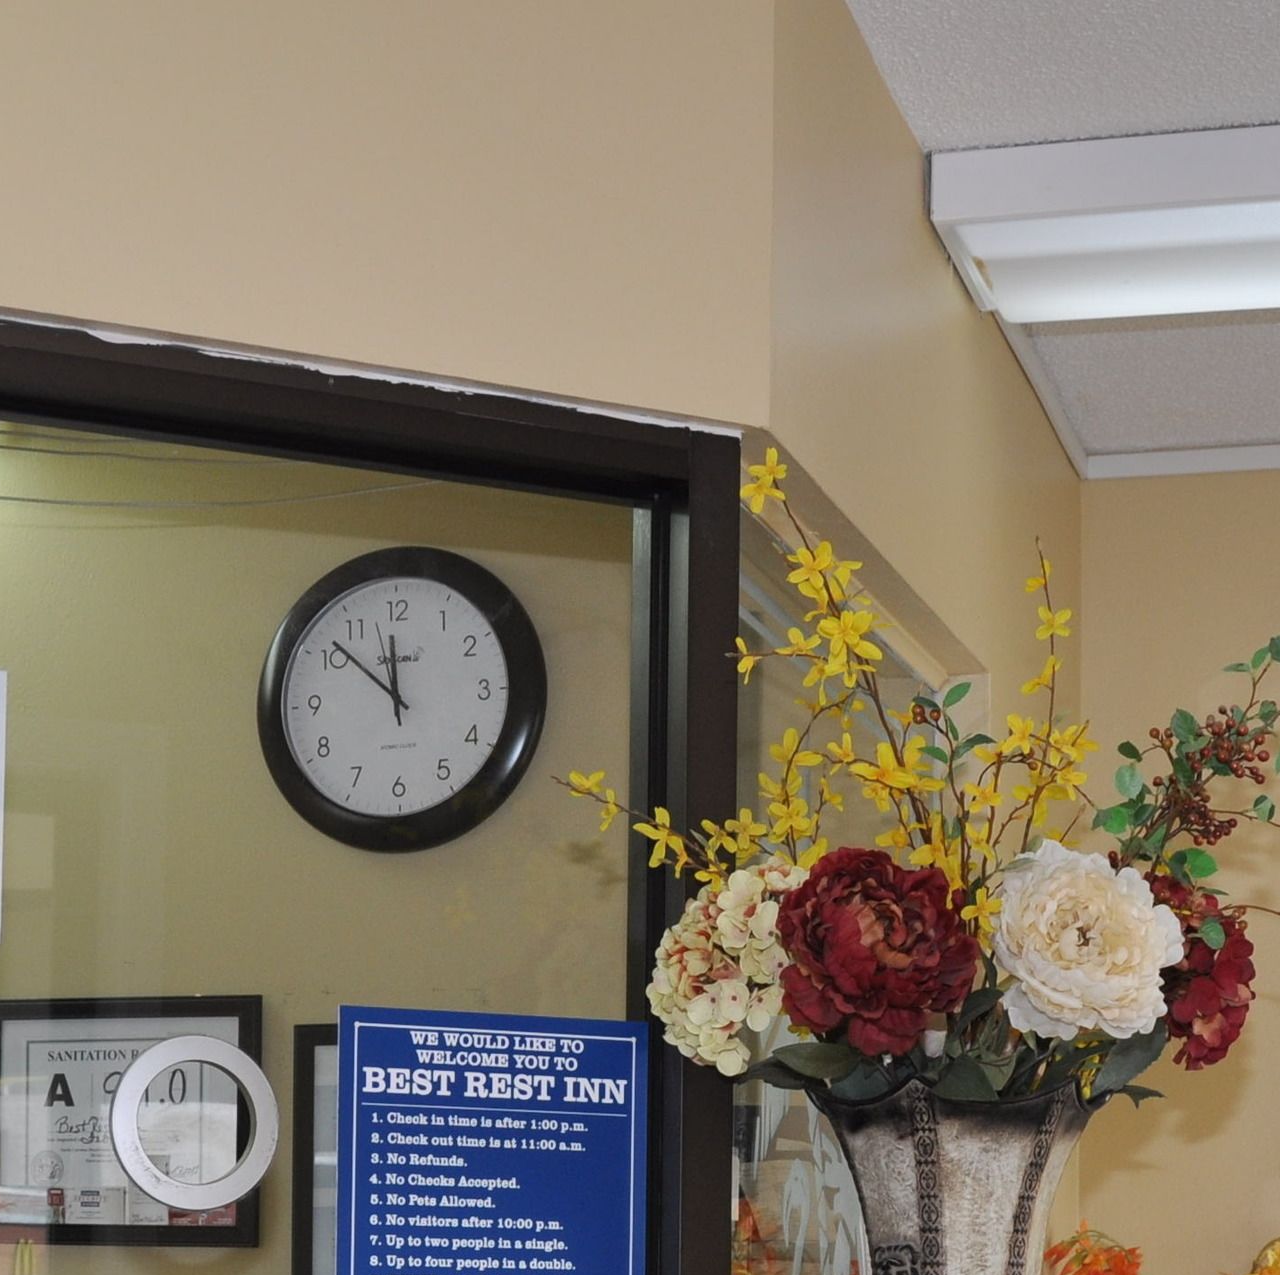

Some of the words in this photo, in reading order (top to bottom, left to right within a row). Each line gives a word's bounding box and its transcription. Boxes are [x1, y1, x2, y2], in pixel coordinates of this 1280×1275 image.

[386, 600, 408, 622] 12
[439, 610, 445, 631] 1
[346, 619, 364, 640] 11
[463, 635, 477, 657] 2
[321, 648, 350, 671] 10
[477, 680, 491, 700] 3
[308, 695, 321, 716] 9
[464, 724, 478, 745] 4
[317, 736, 330, 757] 8
[351, 766, 362, 787] 7
[437, 759, 450, 780] 5
[392, 776, 406, 797] 6
[410, 1031, 438, 1046] WE
[444, 1033, 509, 1049] WOULD
[514, 1038, 556, 1052] LIKE
[560, 1039, 584, 1053] TO
[47, 1050, 127, 1061] SANITATION
[417, 1050, 508, 1067] WELCOME
[513, 1055, 550, 1070] YOU
[554, 1057, 578, 1071] TO
[44, 1073, 75, 1107] A
[362, 1067, 455, 1095] BEST
[464, 1072, 555, 1101] REST
[564, 1077, 627, 1104] INN
[372, 1112, 383, 1123] 1.
[387, 1112, 427, 1125] Check
[431, 1114, 445, 1125] in
[448, 1115, 477, 1127] time
[481, 1117, 492, 1127] is
[496, 1117, 526, 1129] after
[531, 1119, 557, 1131] 1:00
[561, 1122, 588, 1133] p.m.
[372, 1133, 383, 1143] 2.
[387, 1133, 428, 1146] Check
[432, 1136, 453, 1147] out
[457, 1136, 485, 1148] time
[489, 1137, 500, 1148] is
[504, 1138, 517, 1149] at
[521, 1139, 556, 1150] 11:00
[559, 1142, 585, 1151] a.m.
[371, 1154, 383, 1164] 3.
[387, 1154, 406, 1165] No
[409, 1155, 467, 1167] Refunds.
[369, 1174, 381, 1185] 4.
[385, 1174, 405, 1185] No
[408, 1175, 455, 1187] Checks
[458, 1177, 520, 1190] Accepted.
[370, 1195, 382, 1205] 5.
[386, 1194, 405, 1206] No
[409, 1195, 436, 1207] Pets
[440, 1196, 495, 1208] Allowed.
[370, 1215, 381, 1225] 6.
[386, 1215, 405, 1226] No
[408, 1216, 458, 1227] visitors
[462, 1217, 493, 1229] after
[498, 1218, 532, 1229] 10:00
[536, 1221, 563, 1231] p.m.
[370, 1235, 381, 1246] 7.
[386, 1235, 405, 1249] Up
[408, 1237, 421, 1247] to
[425, 1237, 449, 1248] two
[453, 1238, 495, 1251] people
[499, 1238, 511, 1249] in
[515, 1241, 522, 1249] a
[526, 1239, 568, 1252] single.
[370, 1256, 381, 1266] 8.
[387, 1256, 405, 1269] Up
[408, 1257, 421, 1267] to
[425, 1256, 453, 1268] four
[457, 1257, 499, 1271] people
[503, 1258, 515, 1269] in
[519, 1260, 526, 1269] a
[530, 1258, 575, 1271] double.
